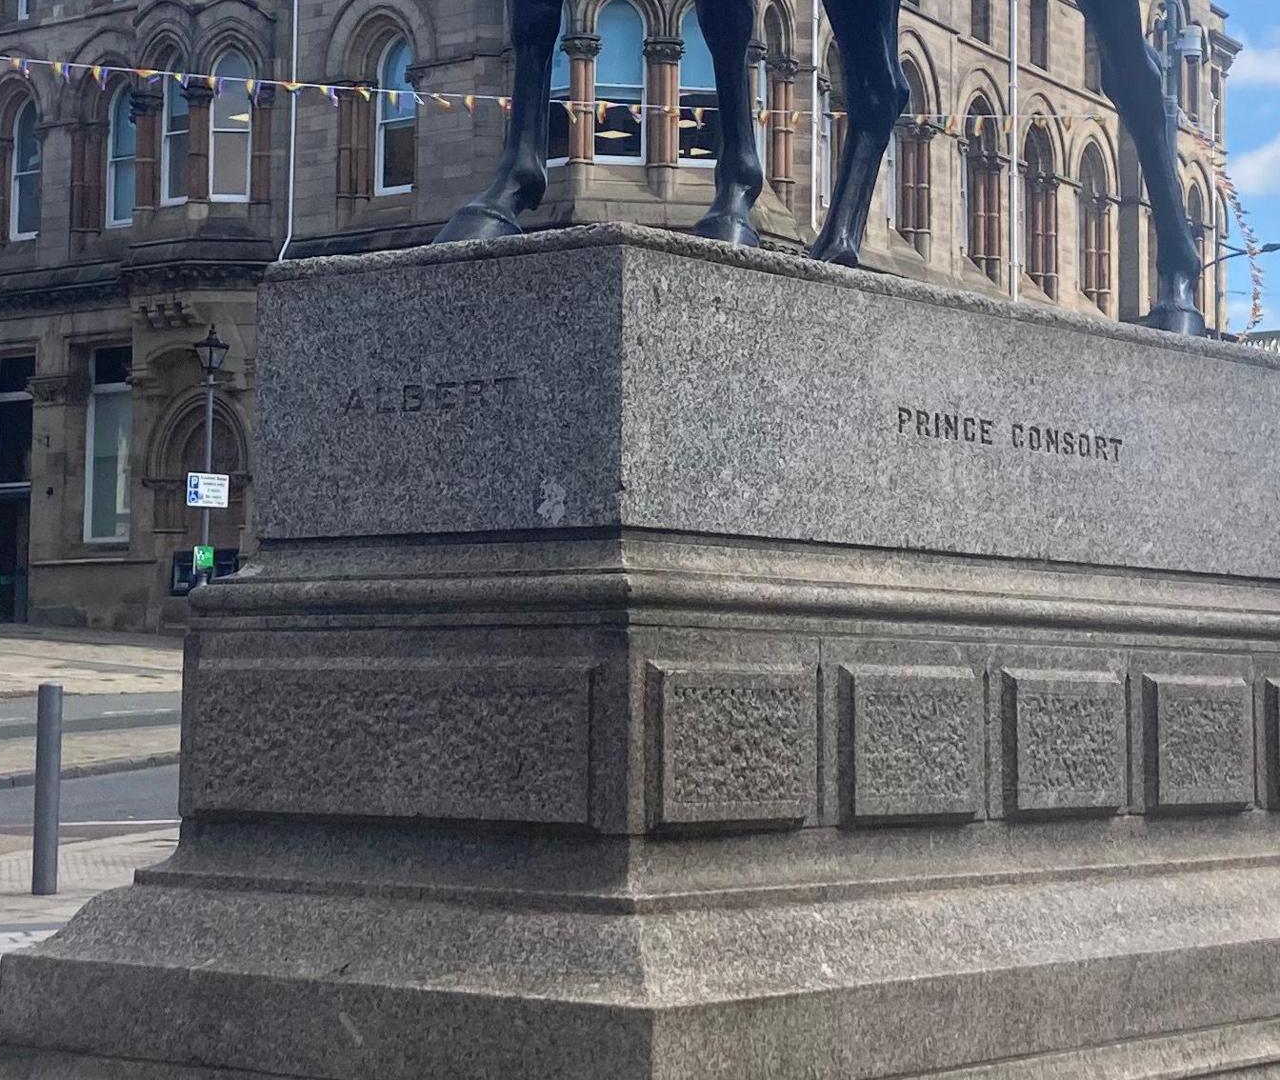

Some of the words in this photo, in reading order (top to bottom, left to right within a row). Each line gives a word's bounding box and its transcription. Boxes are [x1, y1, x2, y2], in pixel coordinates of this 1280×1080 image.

[340, 377, 519, 416] ALBERT
[898, 407, 993, 445] PRINCE
[1012, 423, 1123, 461] CONSORT
